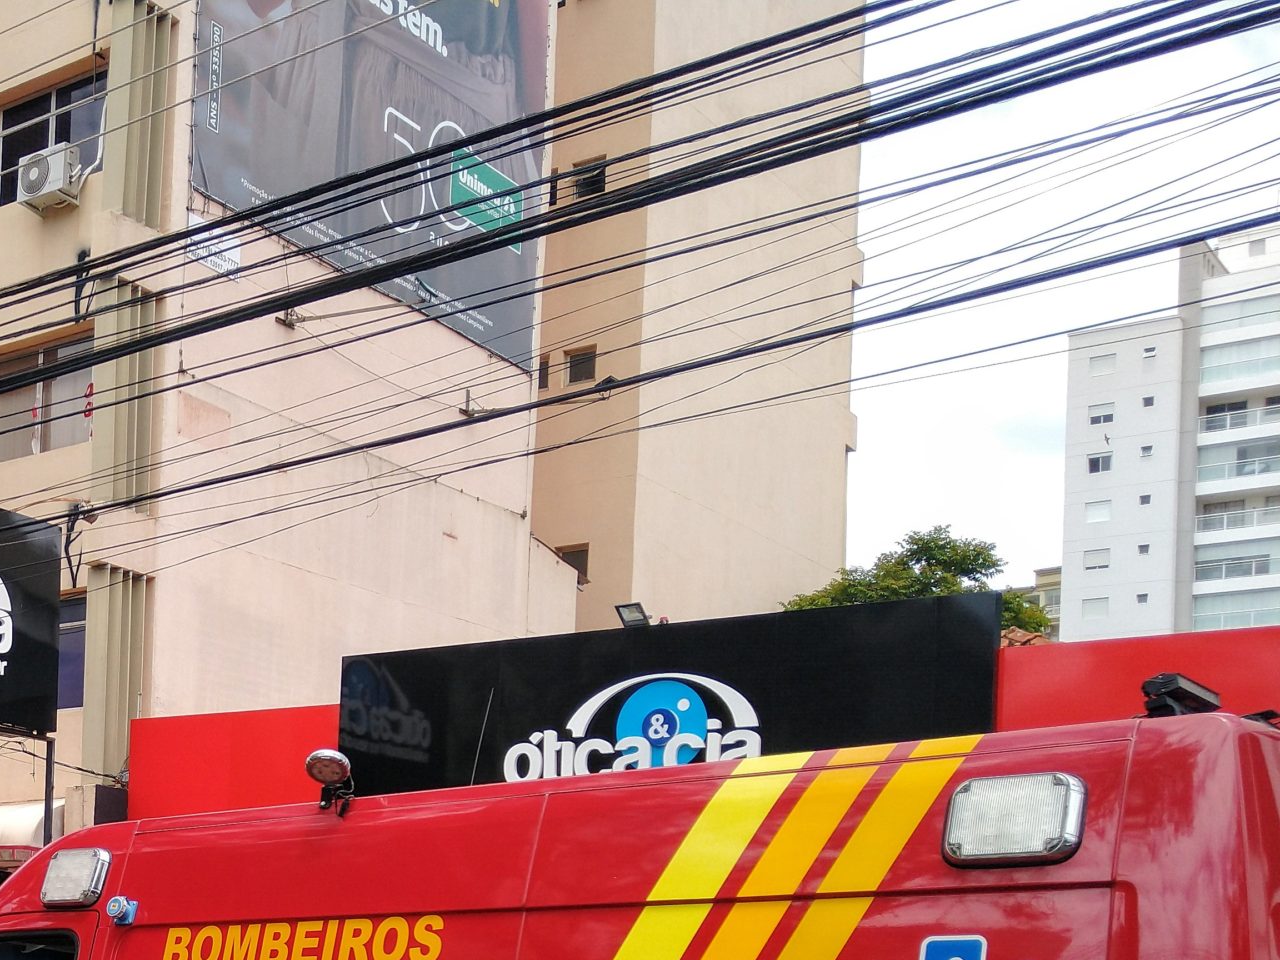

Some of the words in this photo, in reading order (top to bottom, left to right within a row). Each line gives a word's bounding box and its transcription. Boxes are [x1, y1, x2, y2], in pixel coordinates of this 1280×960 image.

[397, 0, 448, 57] tem.
[210, 101, 218, 127] ANS
[503, 729, 652, 783] ótica
[663, 718, 762, 767] cia
